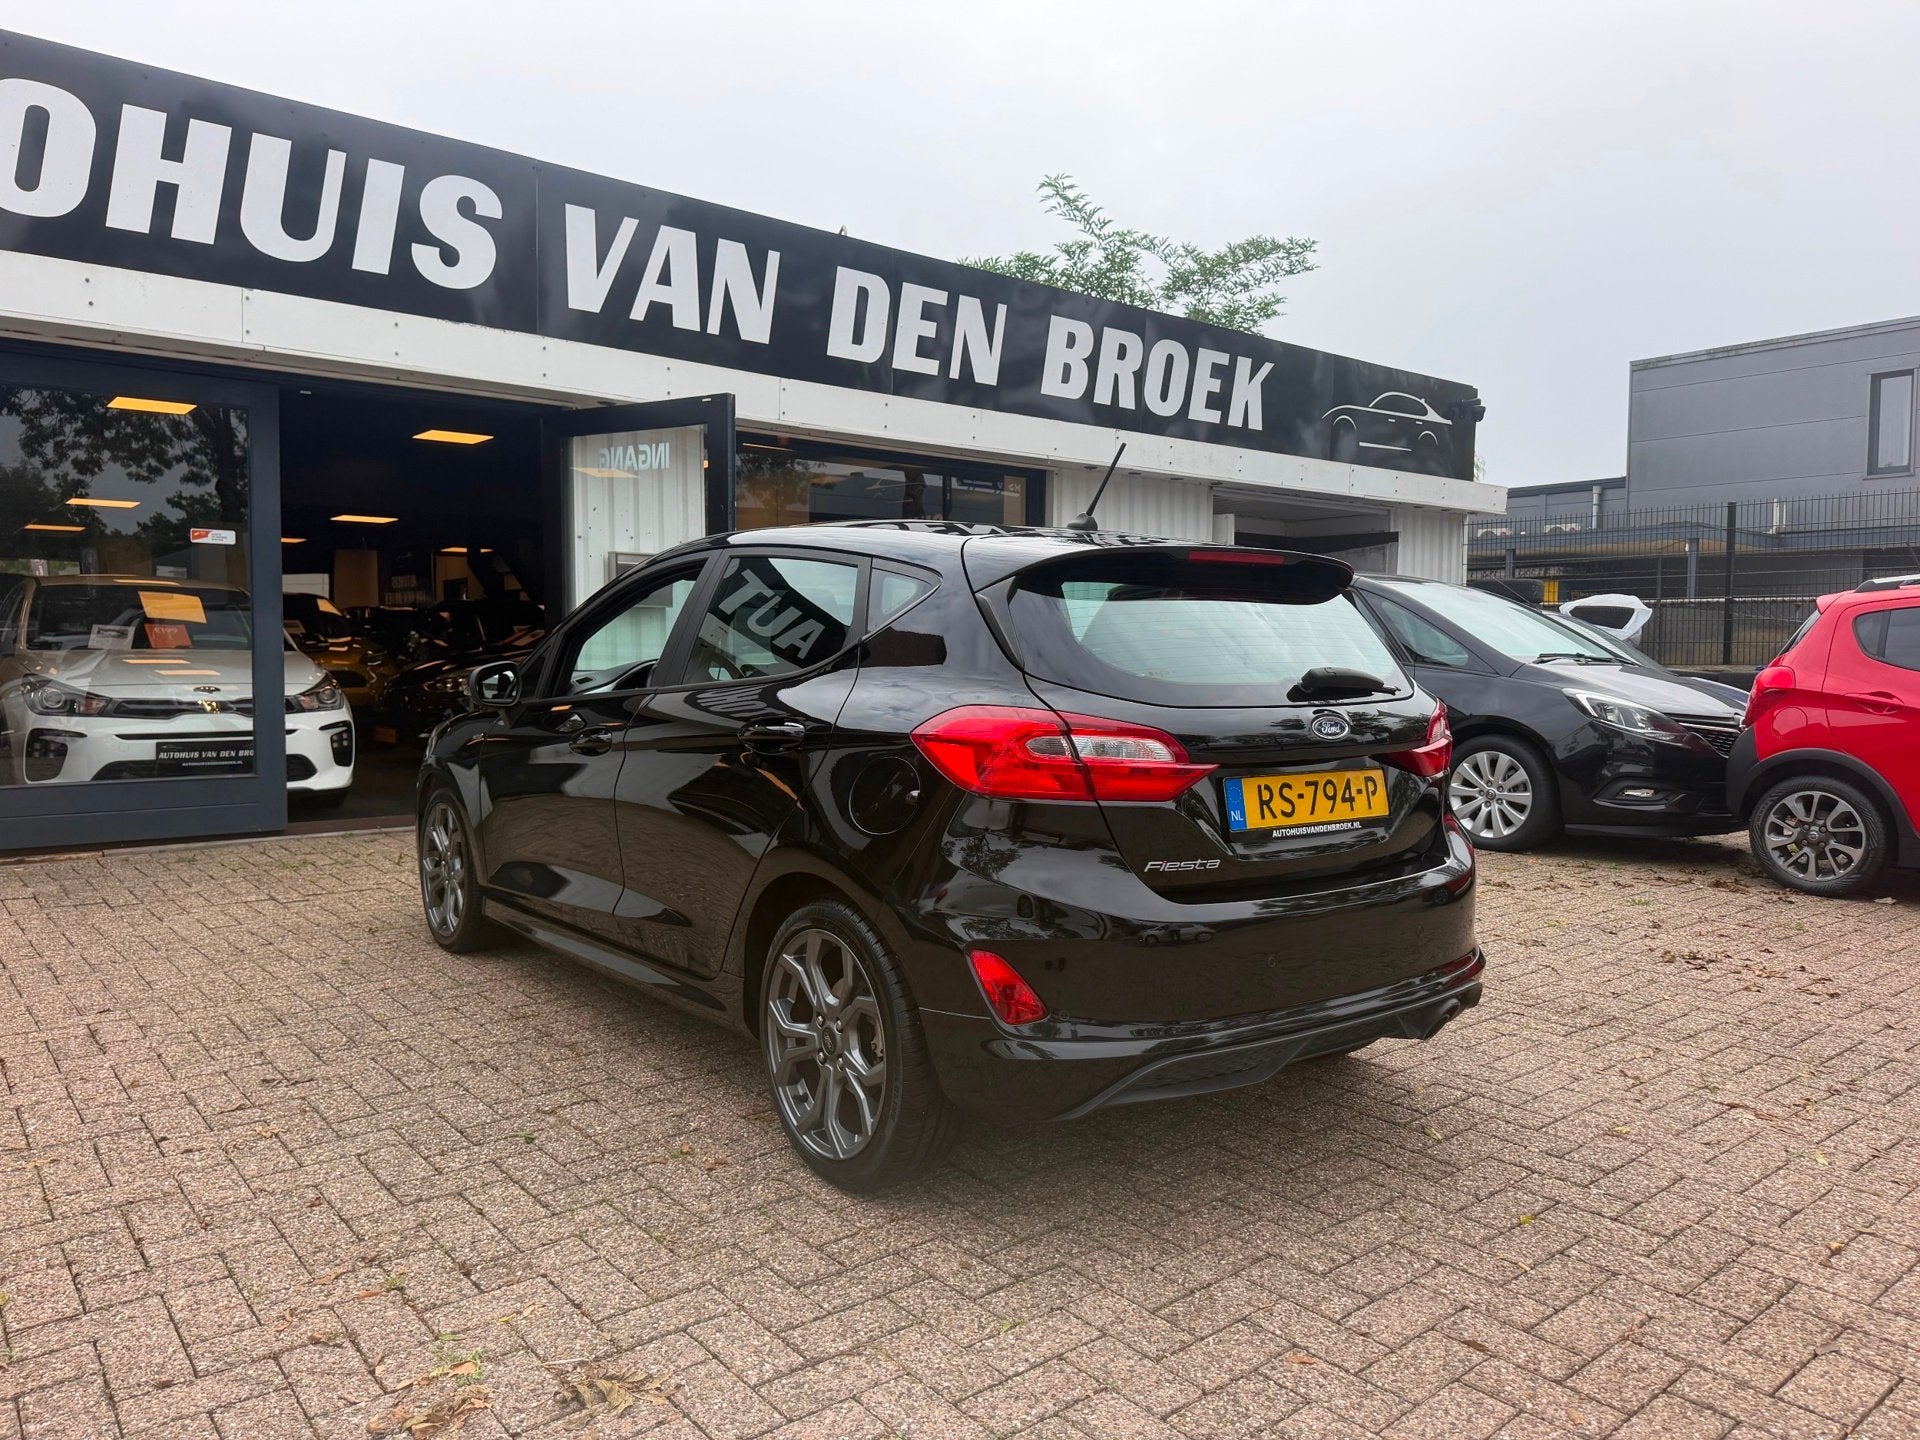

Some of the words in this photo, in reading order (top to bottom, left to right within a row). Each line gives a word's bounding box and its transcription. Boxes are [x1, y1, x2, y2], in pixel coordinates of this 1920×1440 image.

[565, 203, 780, 345] VAN
[827, 266, 1007, 386] DEN
[1041, 315, 1275, 431] BROEK
[158, 751, 200, 759] AUTOHUIS
[1230, 810, 1244, 822] NL
[1257, 775, 1378, 820] RS-794-P
[1272, 821, 1362, 838] AUTOHUISVANDENBROEK.NL
[1144, 859, 1221, 872] Fiesta
